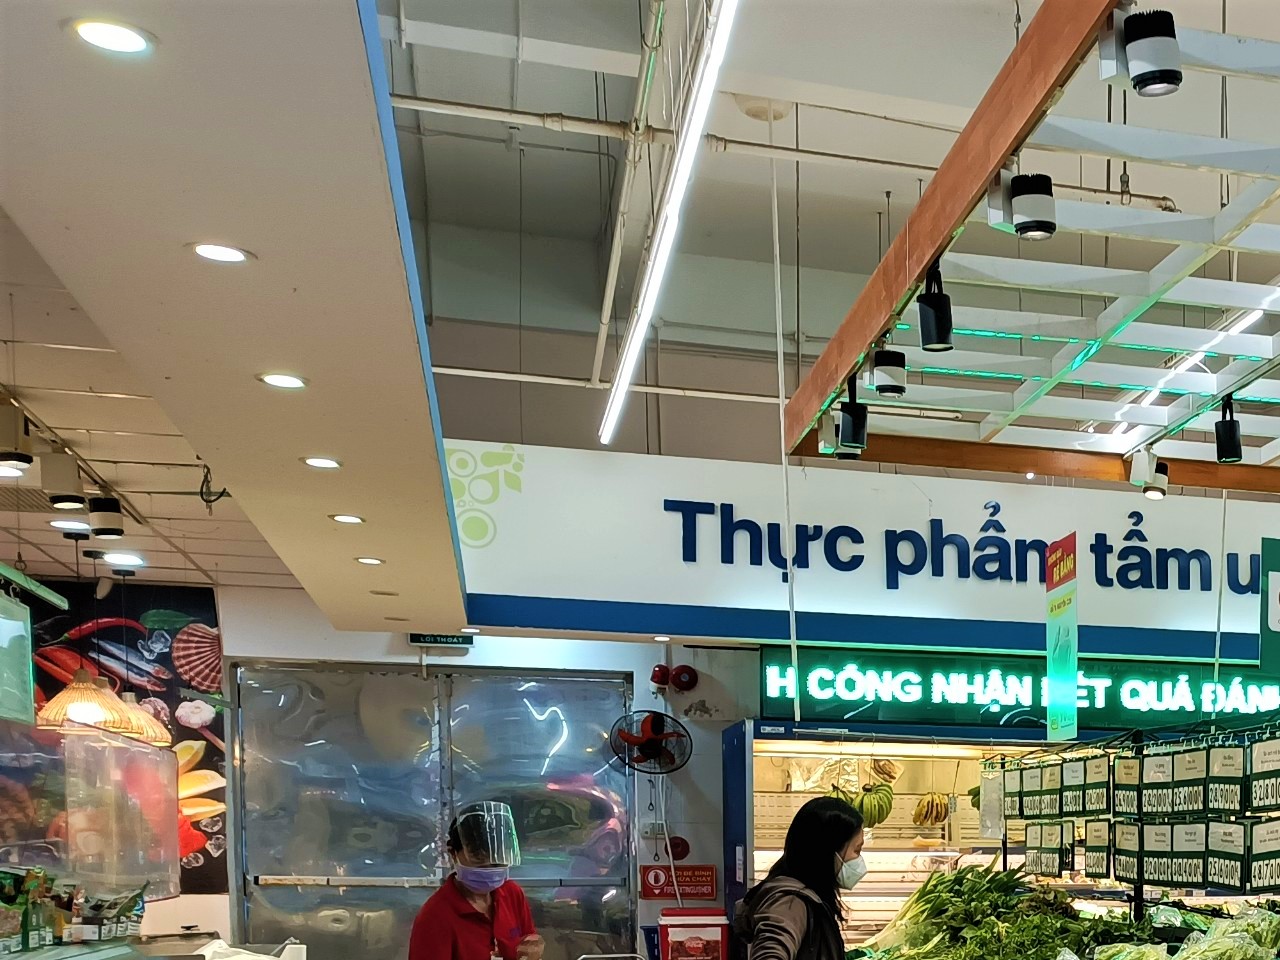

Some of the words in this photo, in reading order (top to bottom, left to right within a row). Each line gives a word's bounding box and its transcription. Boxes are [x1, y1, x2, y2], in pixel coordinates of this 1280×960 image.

[663, 498, 865, 583] Thực
[1089, 510, 1212, 592] tẩm
[806, 662, 923, 703] CÔNG
[931, 668, 1033, 712] NHẬN
[1119, 673, 1195, 712] QUẢ
